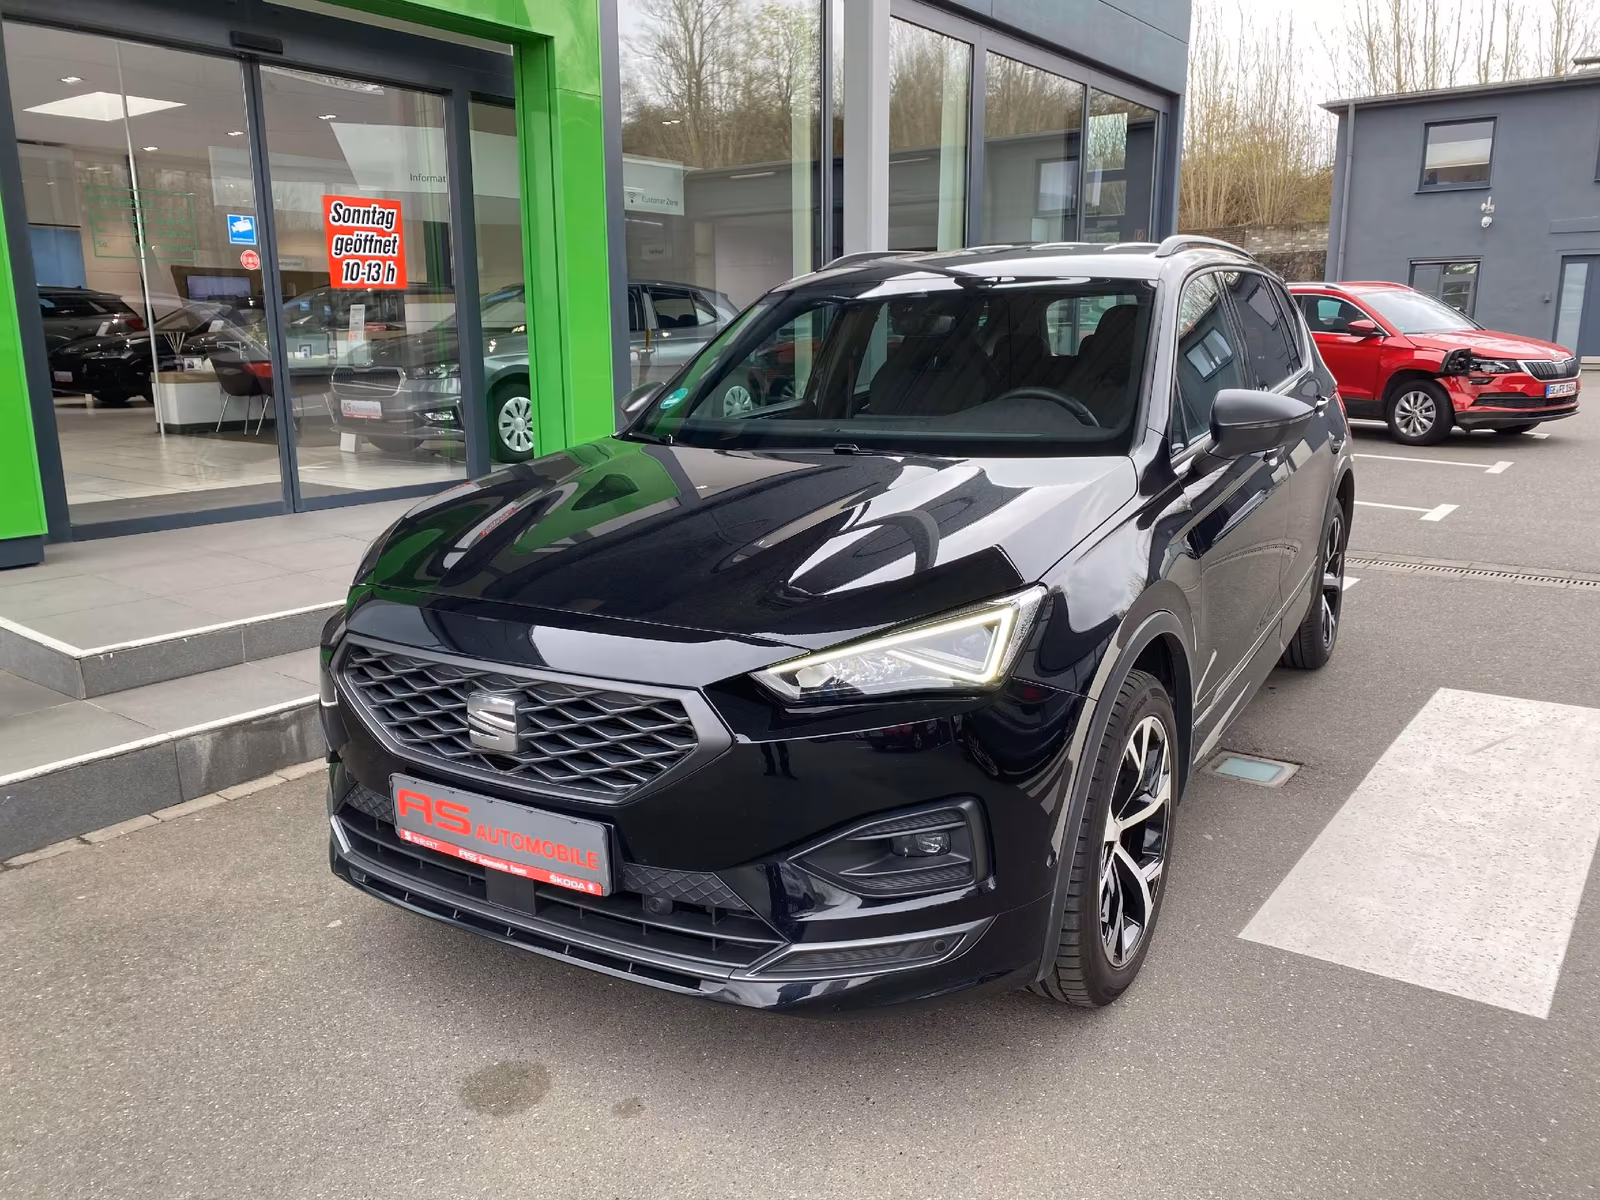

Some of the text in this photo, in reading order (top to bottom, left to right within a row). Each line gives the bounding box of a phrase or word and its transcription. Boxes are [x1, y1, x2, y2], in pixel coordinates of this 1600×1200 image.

[410, 173, 447, 183] Informat
[641, 195, 679, 207] Customer Zone
[330, 201, 396, 231] Sonntag
[333, 232, 399, 257] geöffnet
[343, 260, 397, 283] 10-13 h
[397, 788, 599, 870] AS AUTOMOBILE
[412, 836, 439, 849] SEAT
[549, 873, 586, 891] ŠKODA
